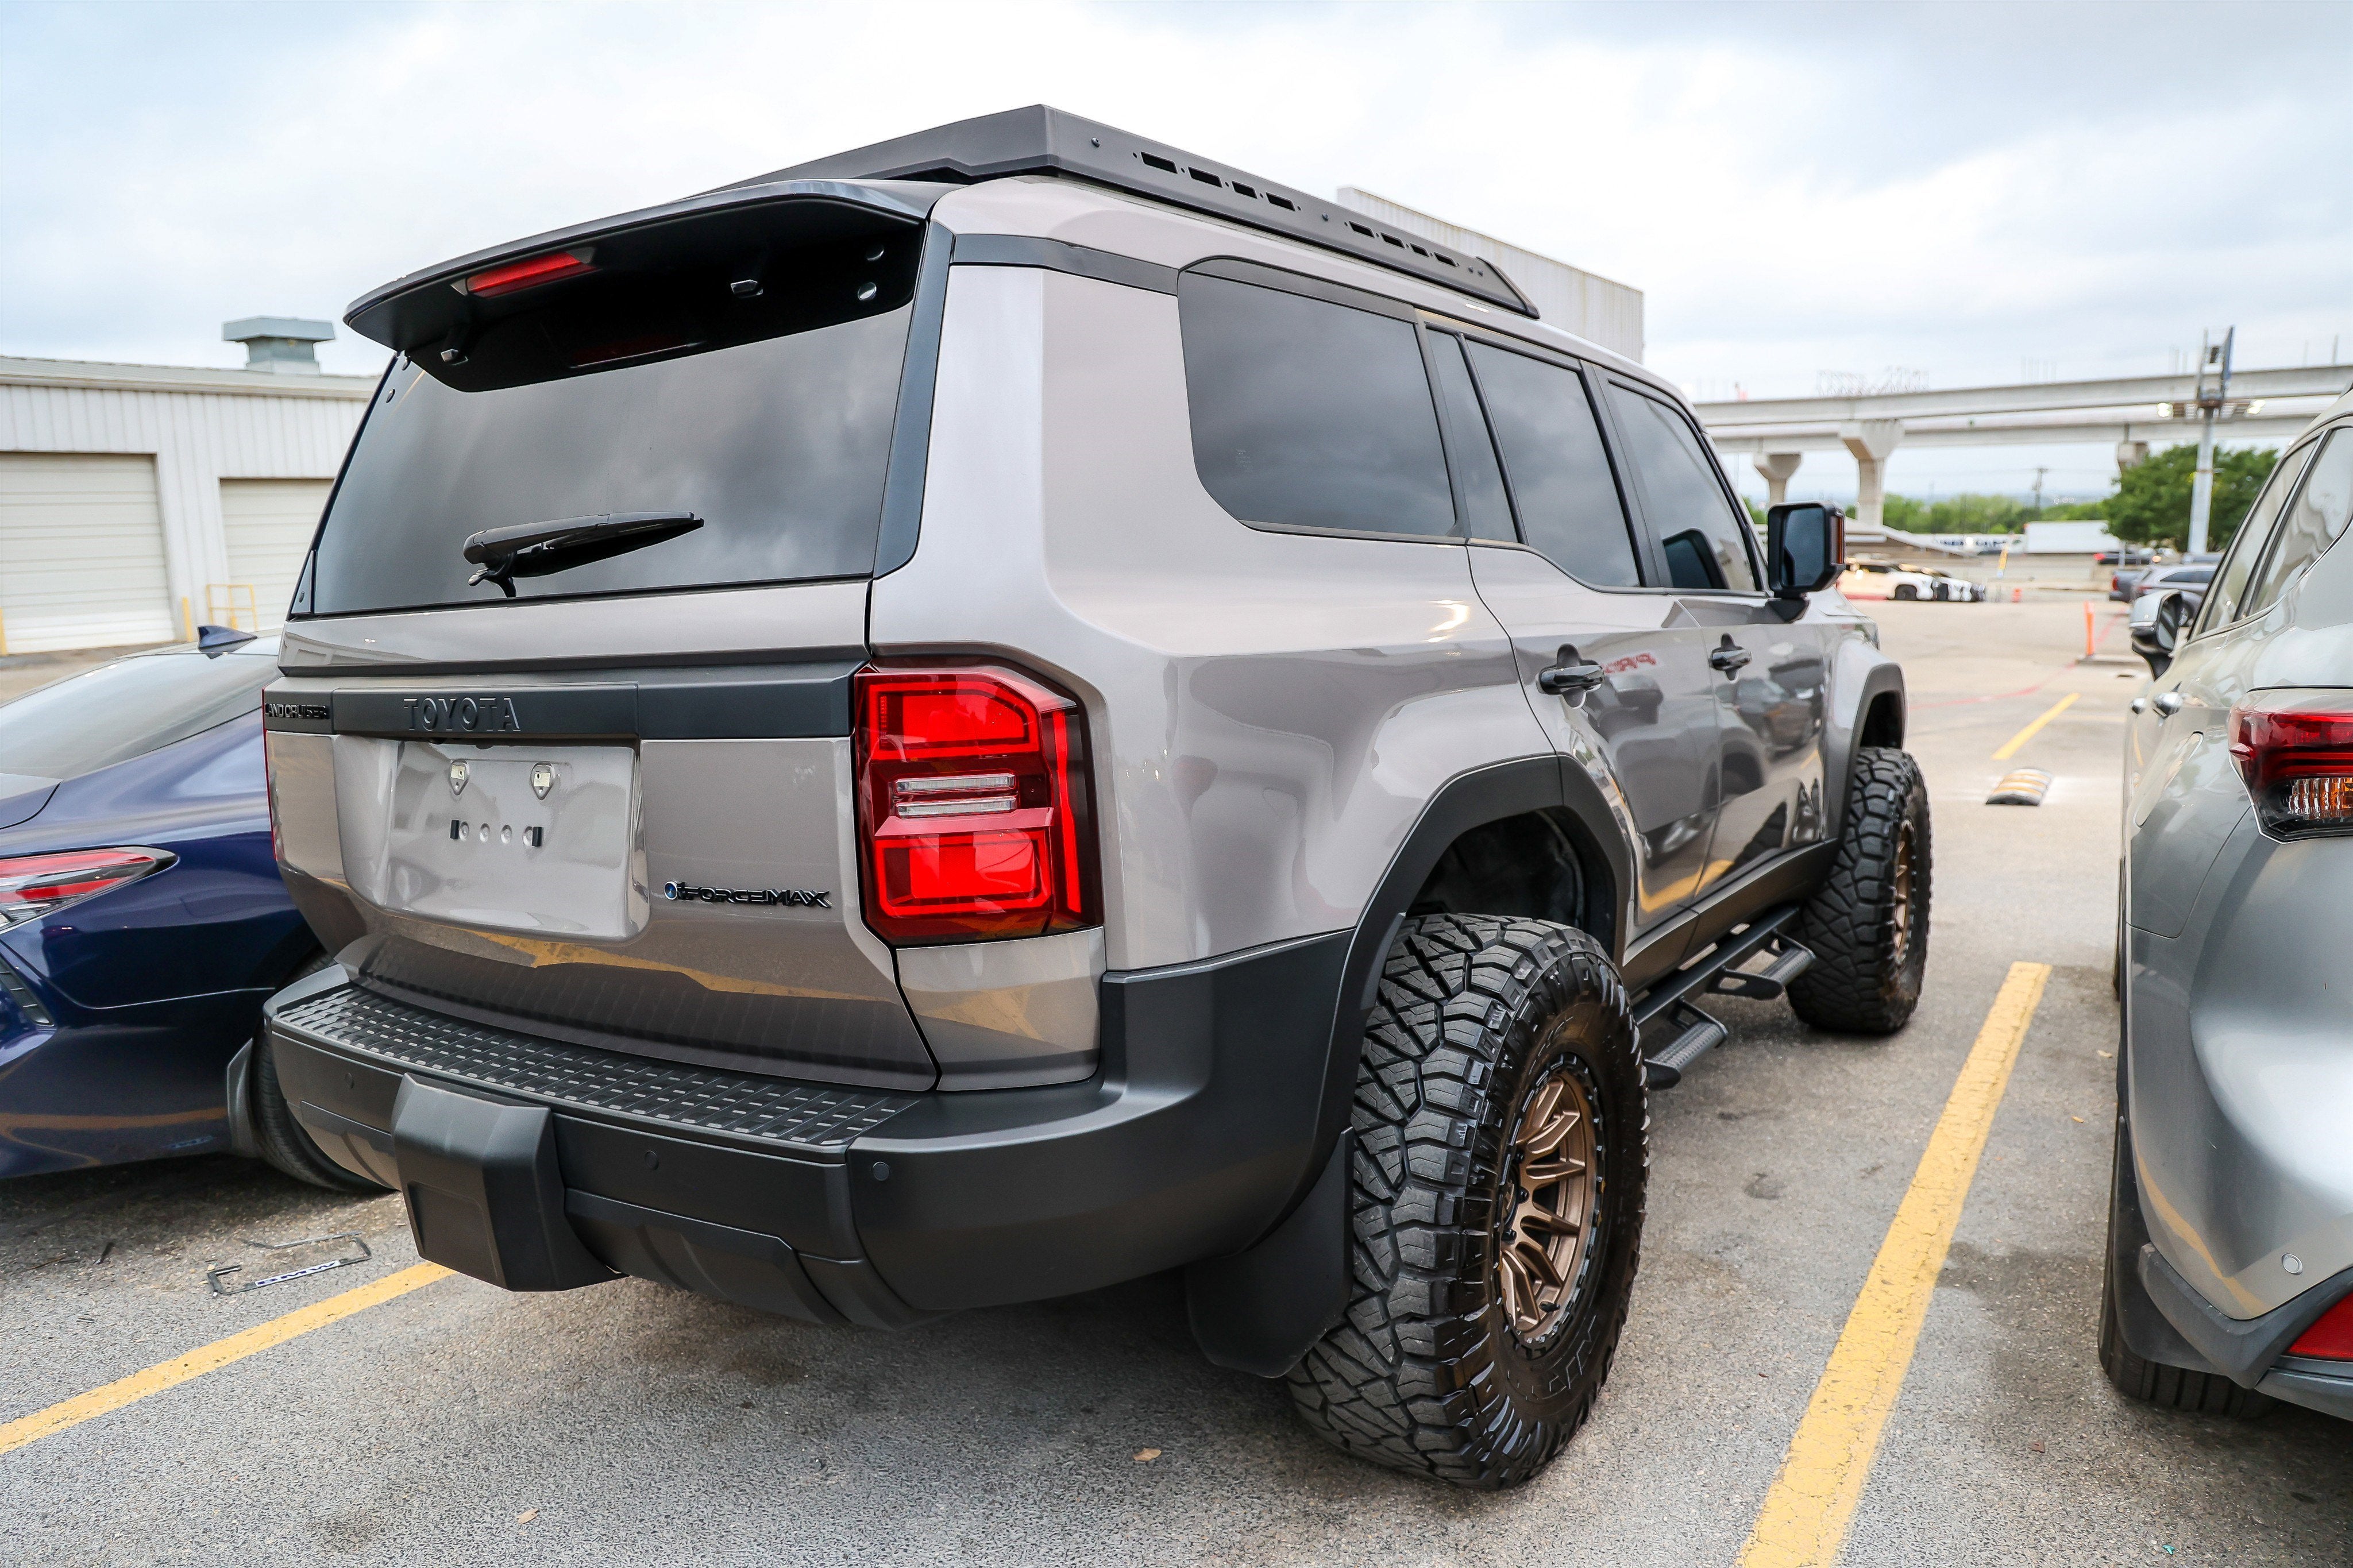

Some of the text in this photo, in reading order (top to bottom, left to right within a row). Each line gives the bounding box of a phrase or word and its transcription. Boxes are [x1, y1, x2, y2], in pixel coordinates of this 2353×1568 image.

[403, 697, 521, 731] TOYOTA
[766, 889, 832, 909] MAX
[257, 1262, 335, 1285] BMW
